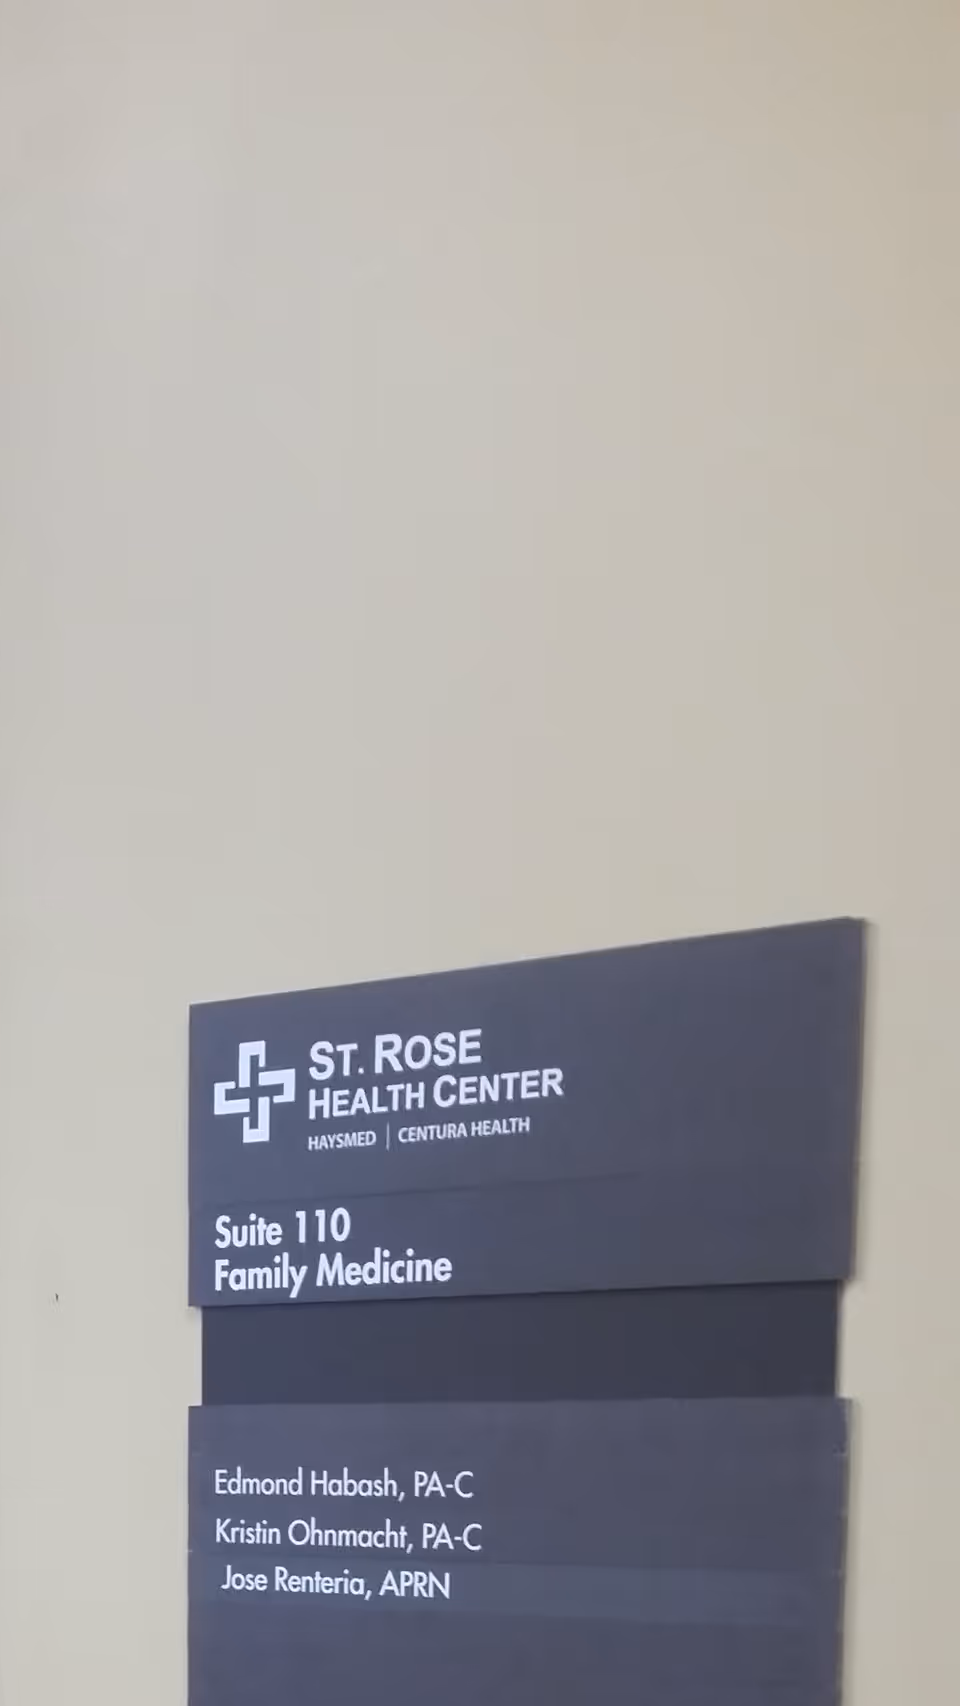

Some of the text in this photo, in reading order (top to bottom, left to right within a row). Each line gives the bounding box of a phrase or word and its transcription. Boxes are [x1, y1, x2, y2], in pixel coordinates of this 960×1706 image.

[374, 1028, 483, 1074] ROSE
[308, 1067, 565, 1120] HEALTH CENTER
[307, 1116, 531, 1151] HAYSMED CENTURA HEALTH
[214, 1207, 352, 1249] Suite 110
[214, 1247, 453, 1298] Family Medicine
[214, 1466, 474, 1502] Edmond Habash, PA-C
[215, 1516, 483, 1554] Kristin Ohnmacht, PA-C
[220, 1564, 451, 1601] Jose Renteria, APRN
